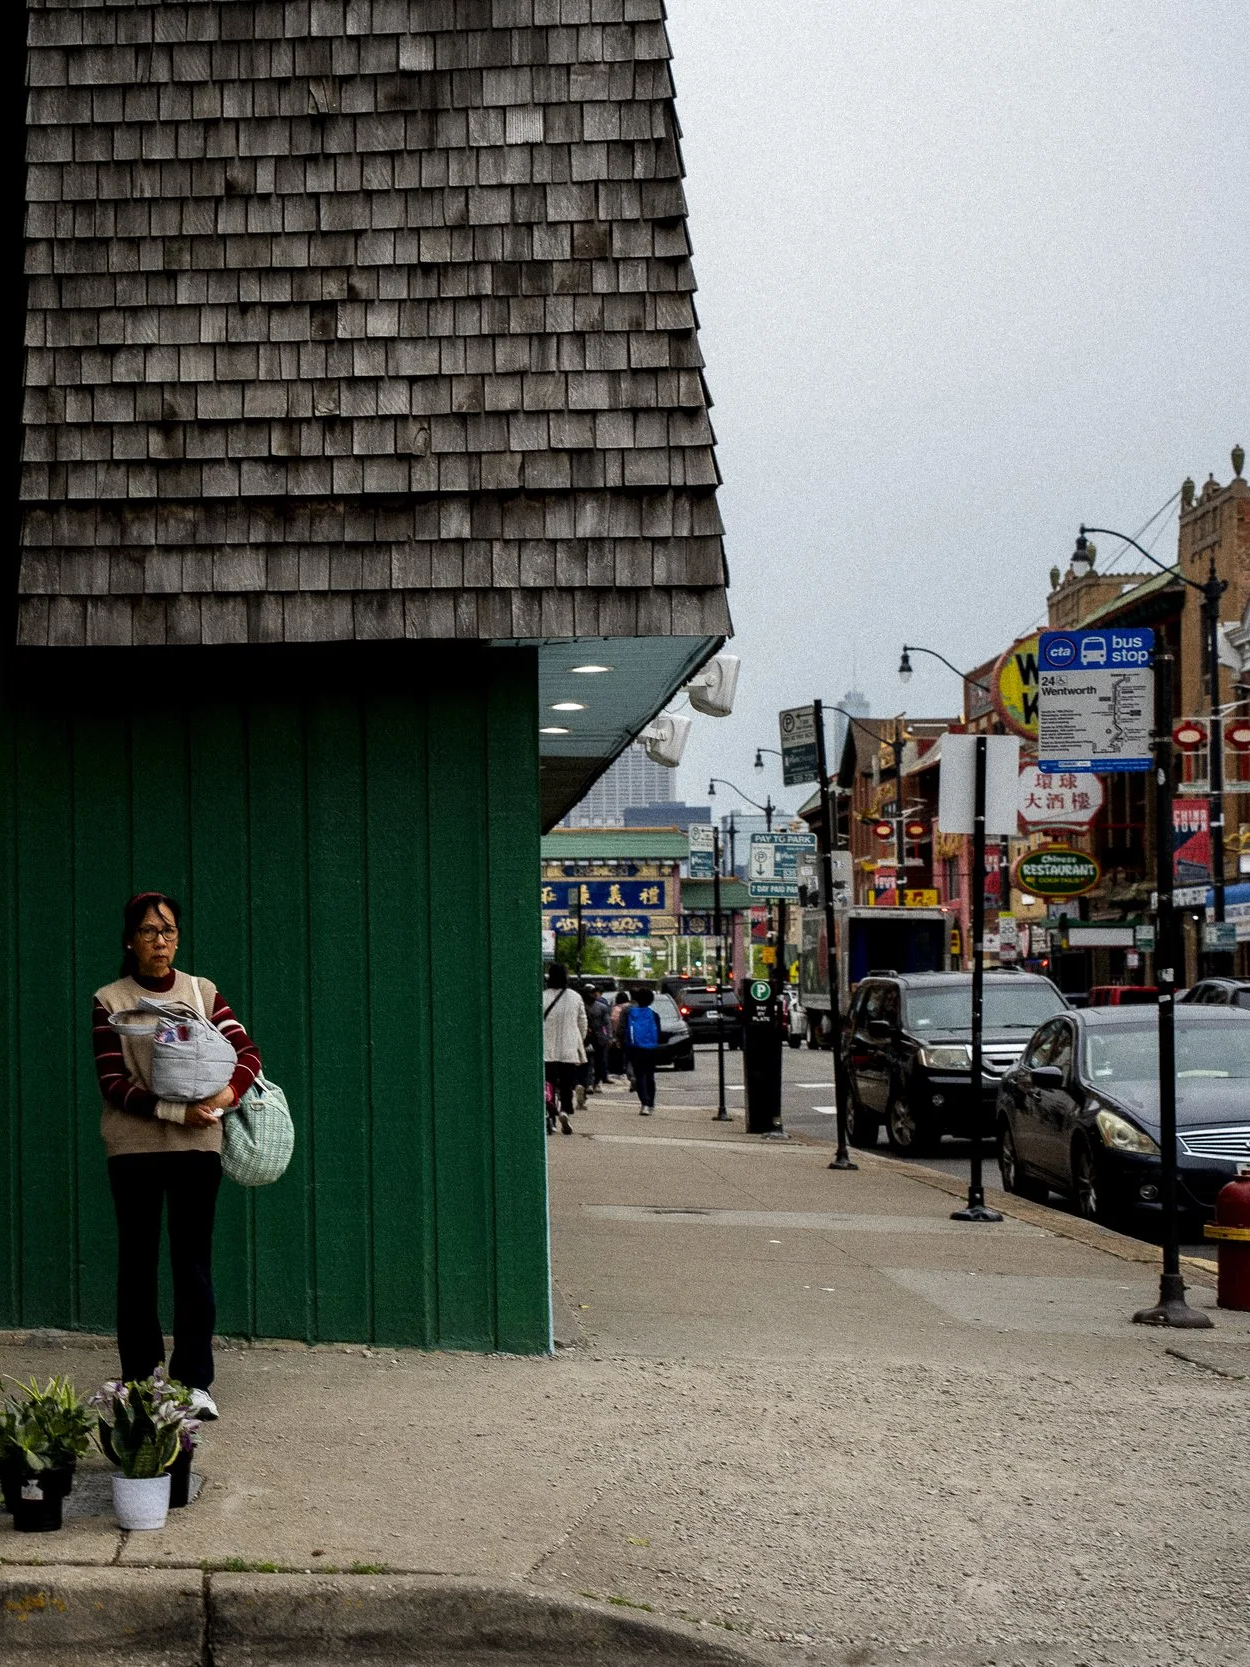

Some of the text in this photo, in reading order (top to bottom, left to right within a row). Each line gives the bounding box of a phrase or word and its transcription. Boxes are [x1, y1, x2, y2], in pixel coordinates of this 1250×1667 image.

[1112, 635, 1143, 648] bus
[1050, 647, 1071, 657] cta
[1112, 649, 1149, 664] stop
[1041, 677, 1055, 686] 24
[1042, 686, 1097, 697] Wentworth
[1173, 810, 1208, 821] CHINA
[1174, 821, 1208, 832] TOWN
[774, 835, 785, 843] TO
[787, 835, 811, 843] PARK
[1041, 855, 1077, 863] Chinese
[1023, 864, 1095, 876] RESTAURANT
[757, 984, 767, 998] P
